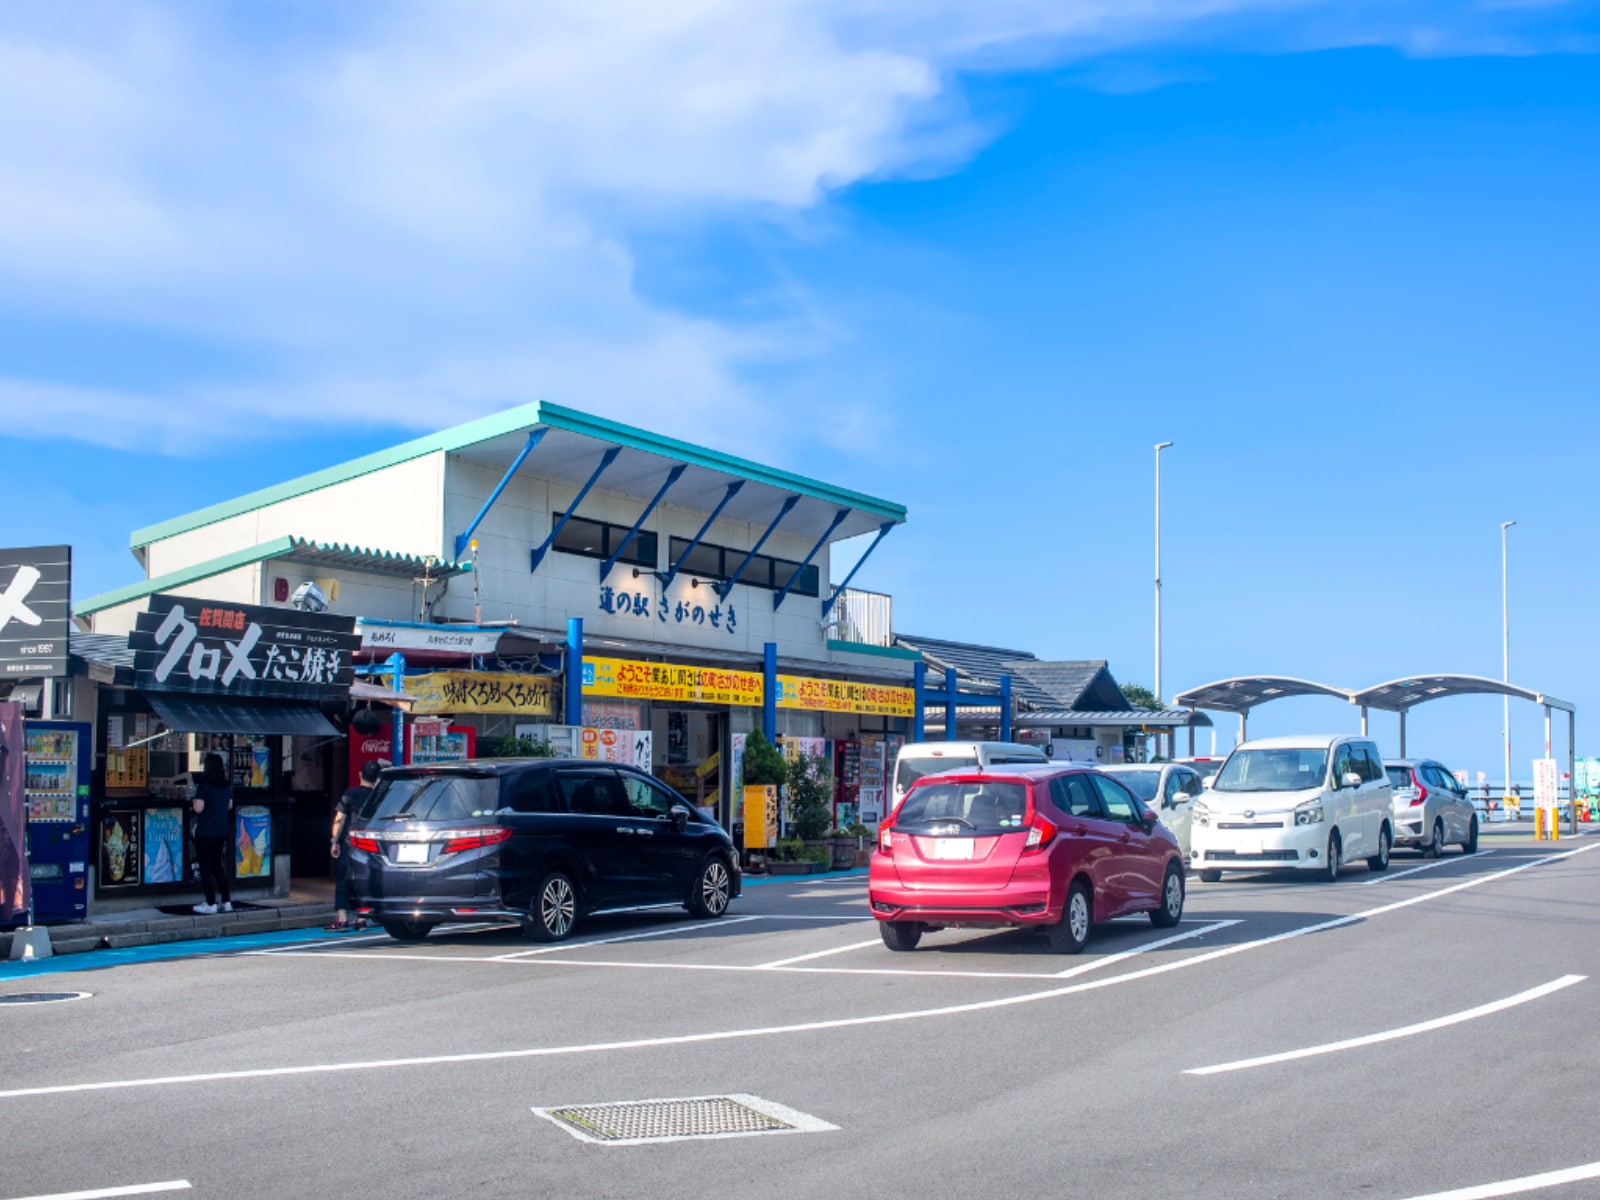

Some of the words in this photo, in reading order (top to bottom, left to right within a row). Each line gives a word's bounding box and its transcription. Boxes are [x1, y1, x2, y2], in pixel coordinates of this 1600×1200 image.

[199, 607, 248, 631] 佐賀関店
[598, 585, 650, 618] 道の駅
[657, 594, 737, 634] さがのせき
[154, 604, 263, 688] クロメ
[262, 643, 342, 684] たこ焼き
